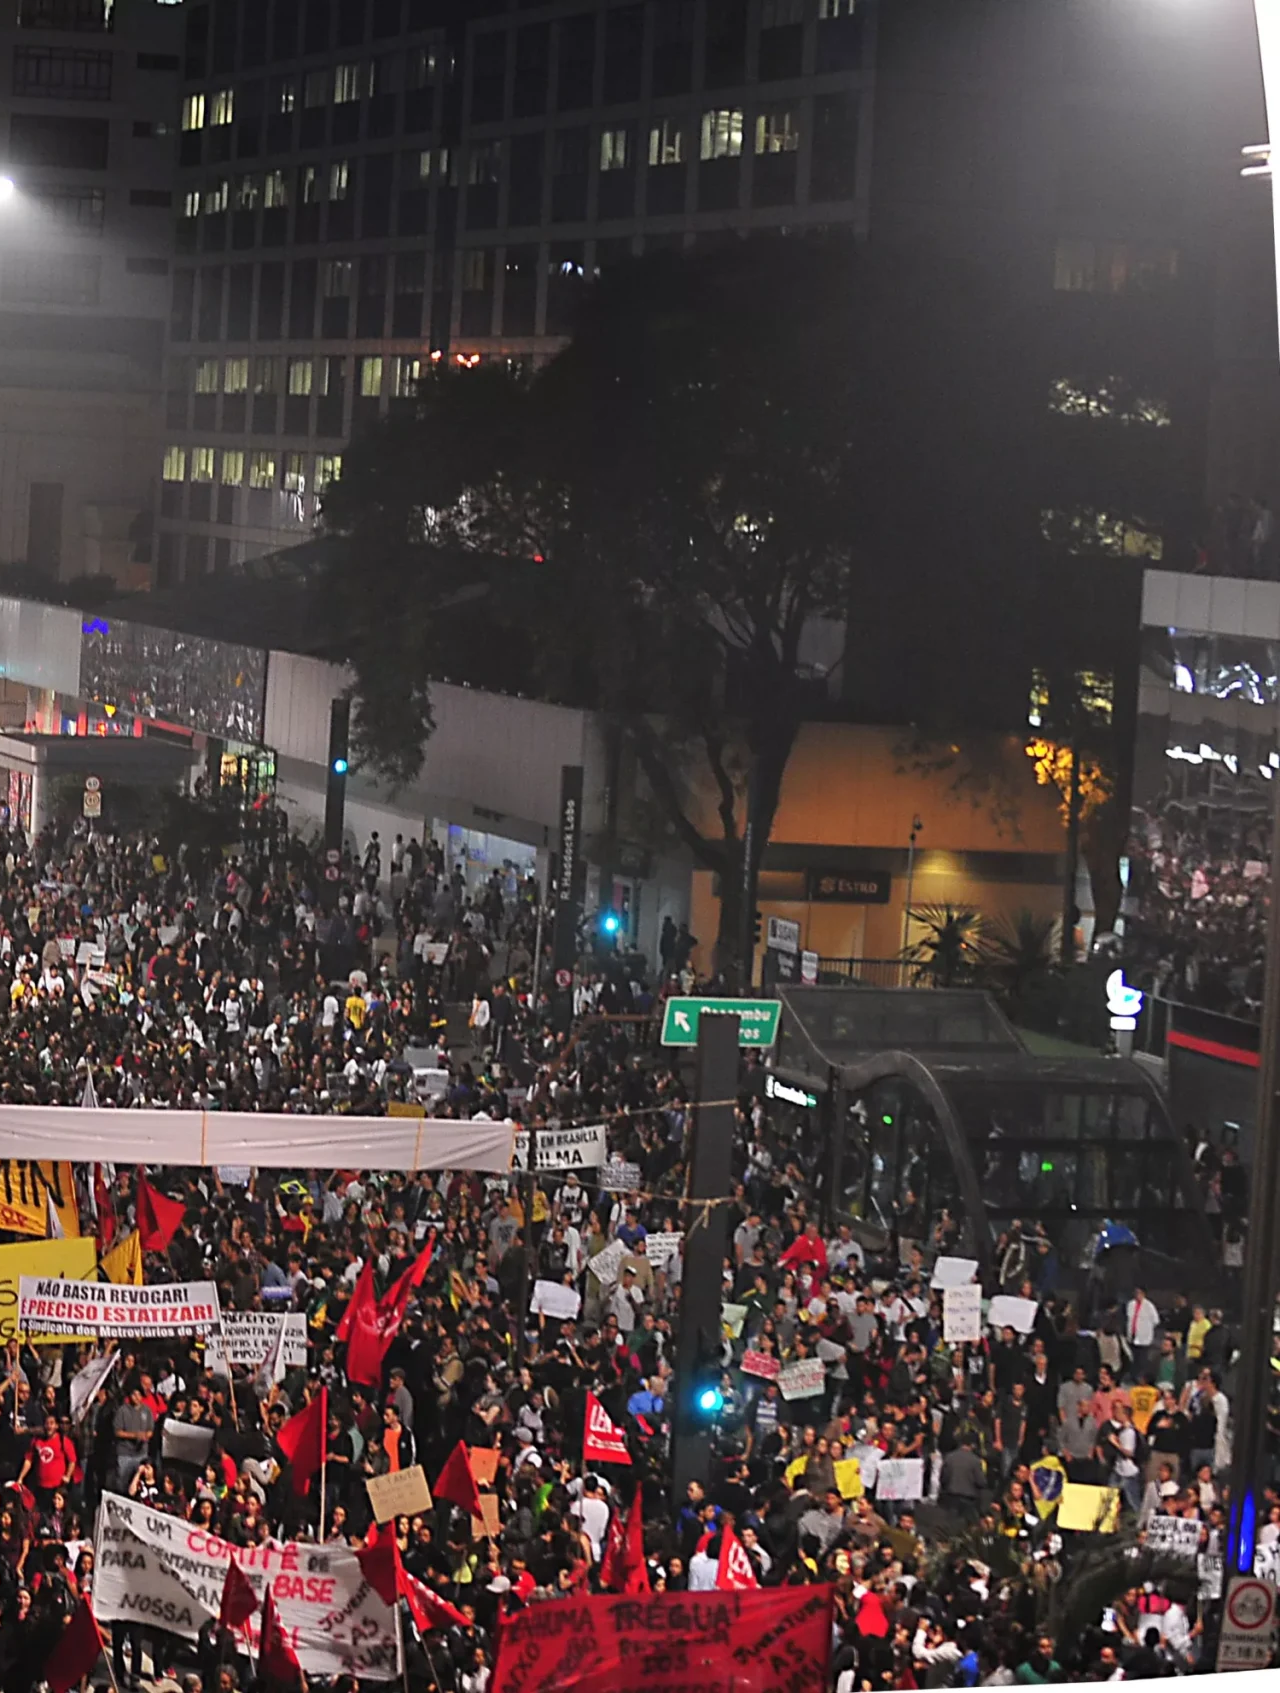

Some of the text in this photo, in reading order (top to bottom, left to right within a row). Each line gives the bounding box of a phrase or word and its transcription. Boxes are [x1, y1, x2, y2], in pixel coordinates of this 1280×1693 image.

[541, 1135, 554, 1148] EM
[535, 1149, 583, 1168] ILMA
[36, 1279, 188, 1303] NÃO BASTA REVOGAR!
[28, 1299, 97, 1321] PRECISO
[103, 1303, 213, 1323] ESTATIZAR!
[28, 1319, 73, 1335] Sindicato
[76, 1323, 96, 1337] dos
[99, 1324, 175, 1338] Metroviários
[195, 1325, 213, 1337] SP
[106, 1501, 132, 1525] POR
[146, 1517, 172, 1540] UM
[101, 1549, 146, 1570] PARA
[272, 1574, 337, 1604] BASE
[121, 1592, 194, 1627] NOSSA
